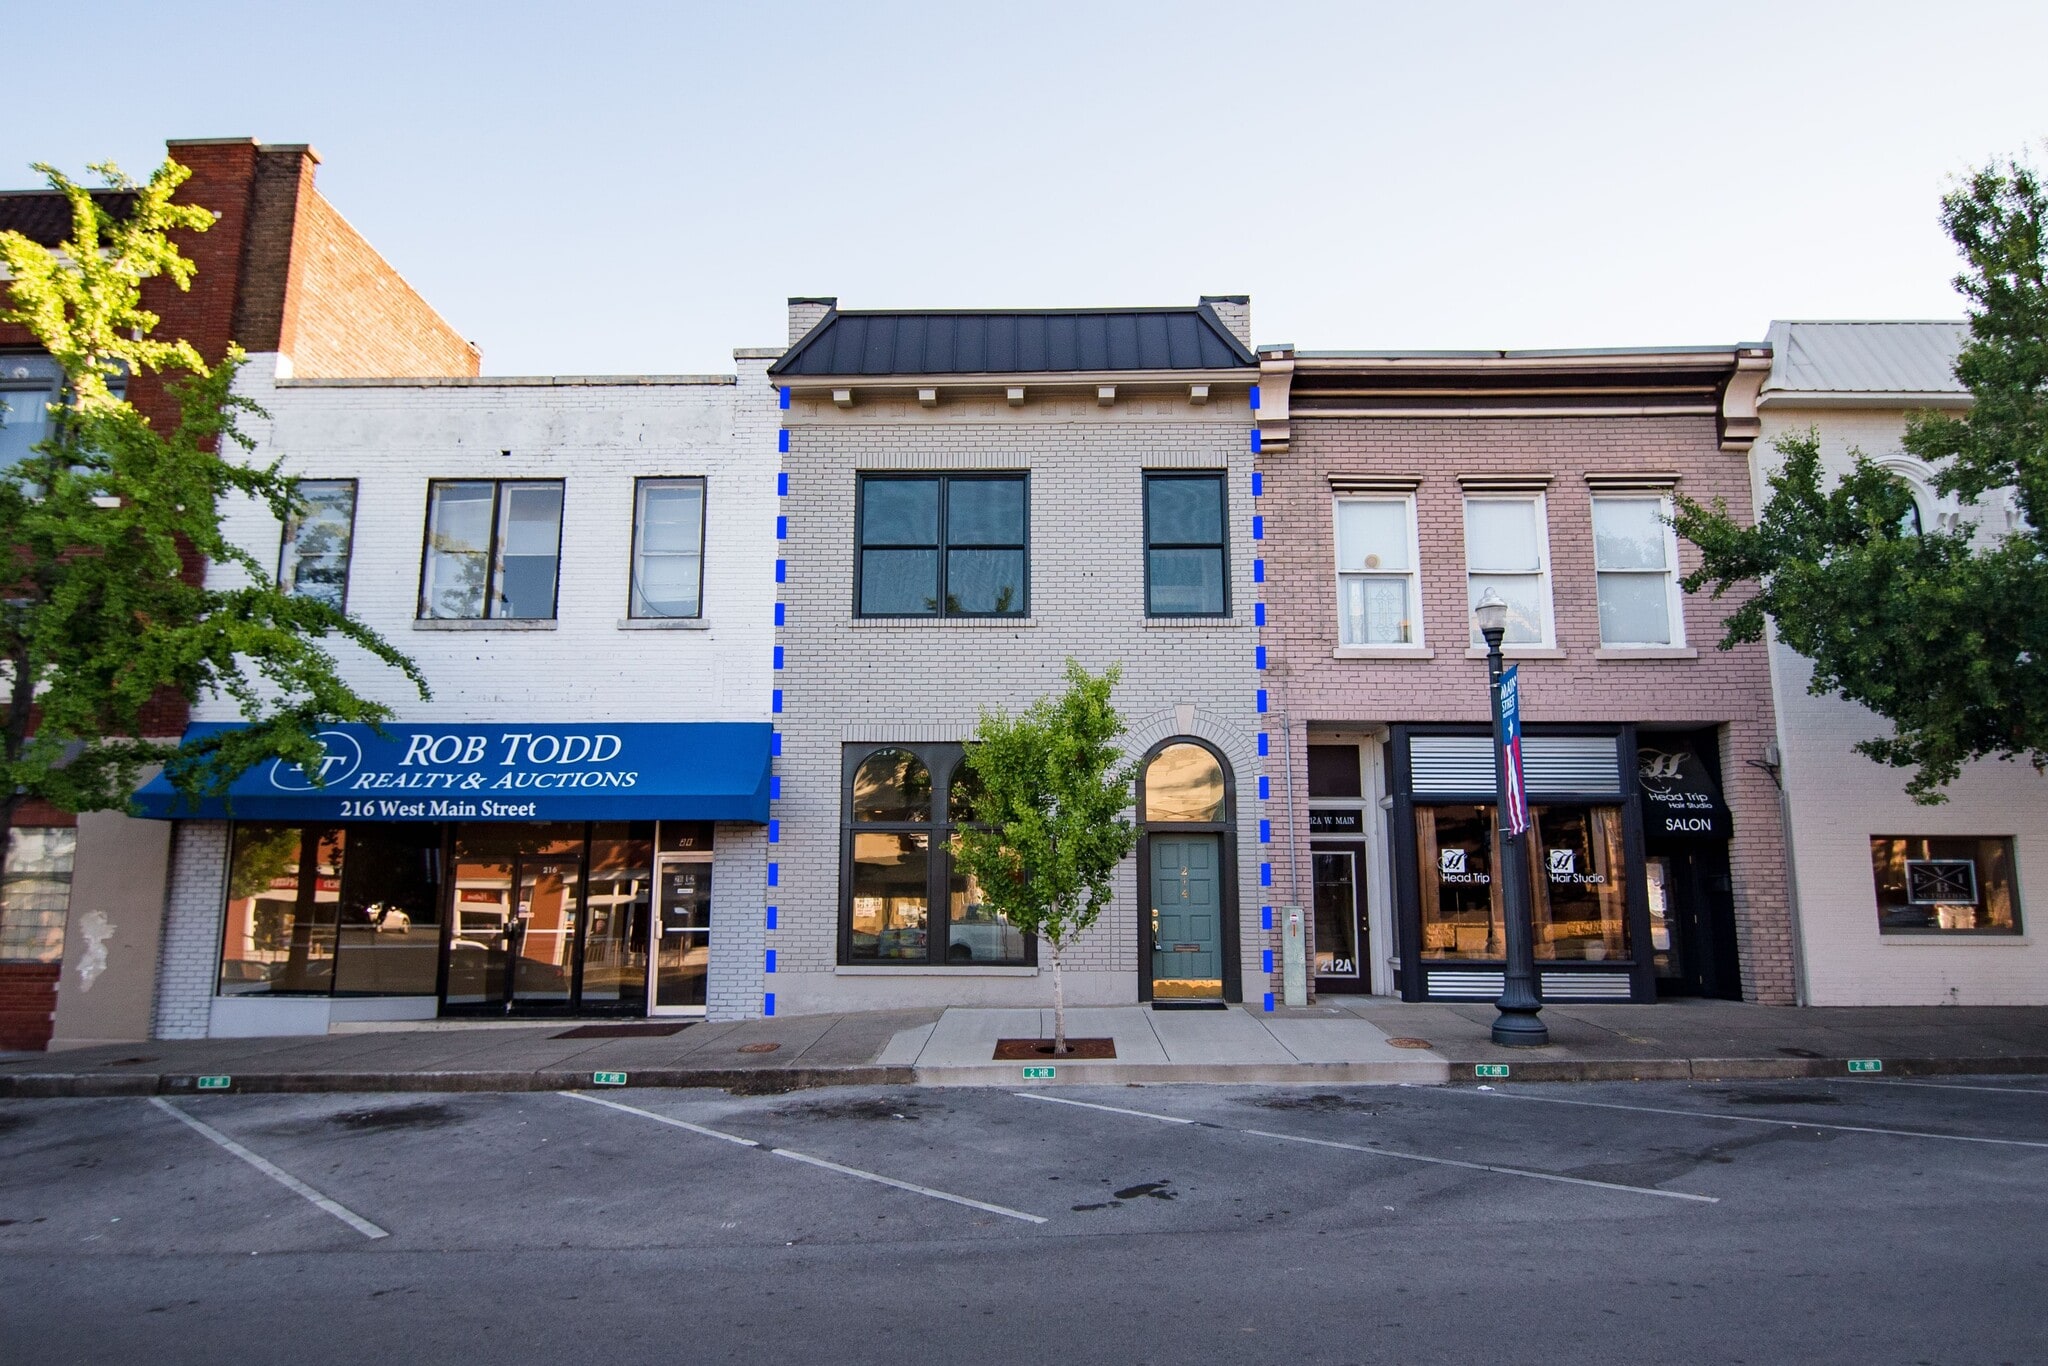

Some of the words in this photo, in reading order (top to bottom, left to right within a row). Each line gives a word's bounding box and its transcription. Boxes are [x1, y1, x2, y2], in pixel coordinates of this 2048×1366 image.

[398, 734, 488, 766] ROB
[499, 733, 622, 766] TODD
[350, 772, 464, 790] REALTY
[490, 771, 639, 790] AUCTIONS
[1648, 792, 1684, 801] Head
[1685, 792, 1709, 803] Trip
[340, 800, 375, 817] 216
[378, 801, 425, 817] West
[428, 800, 477, 817] Main
[481, 800, 536, 817] Street
[1310, 816, 1322, 825] 12A
[1335, 816, 1355, 825] MAIN
[1665, 818, 1712, 831] SALON
[542, 866, 558, 874] 216
[1442, 872, 1472, 883] Head
[1473, 872, 1490, 884] Trip
[1551, 873, 1571, 883] Hair
[1573, 873, 1605, 883] Studio
[1320, 958, 1353, 972] 212A
[1029, 1068, 1035, 1077] 2
[1038, 1068, 1049, 1077] HR
[1482, 1066, 1488, 1075] 2
[600, 1073, 607, 1082] 2
